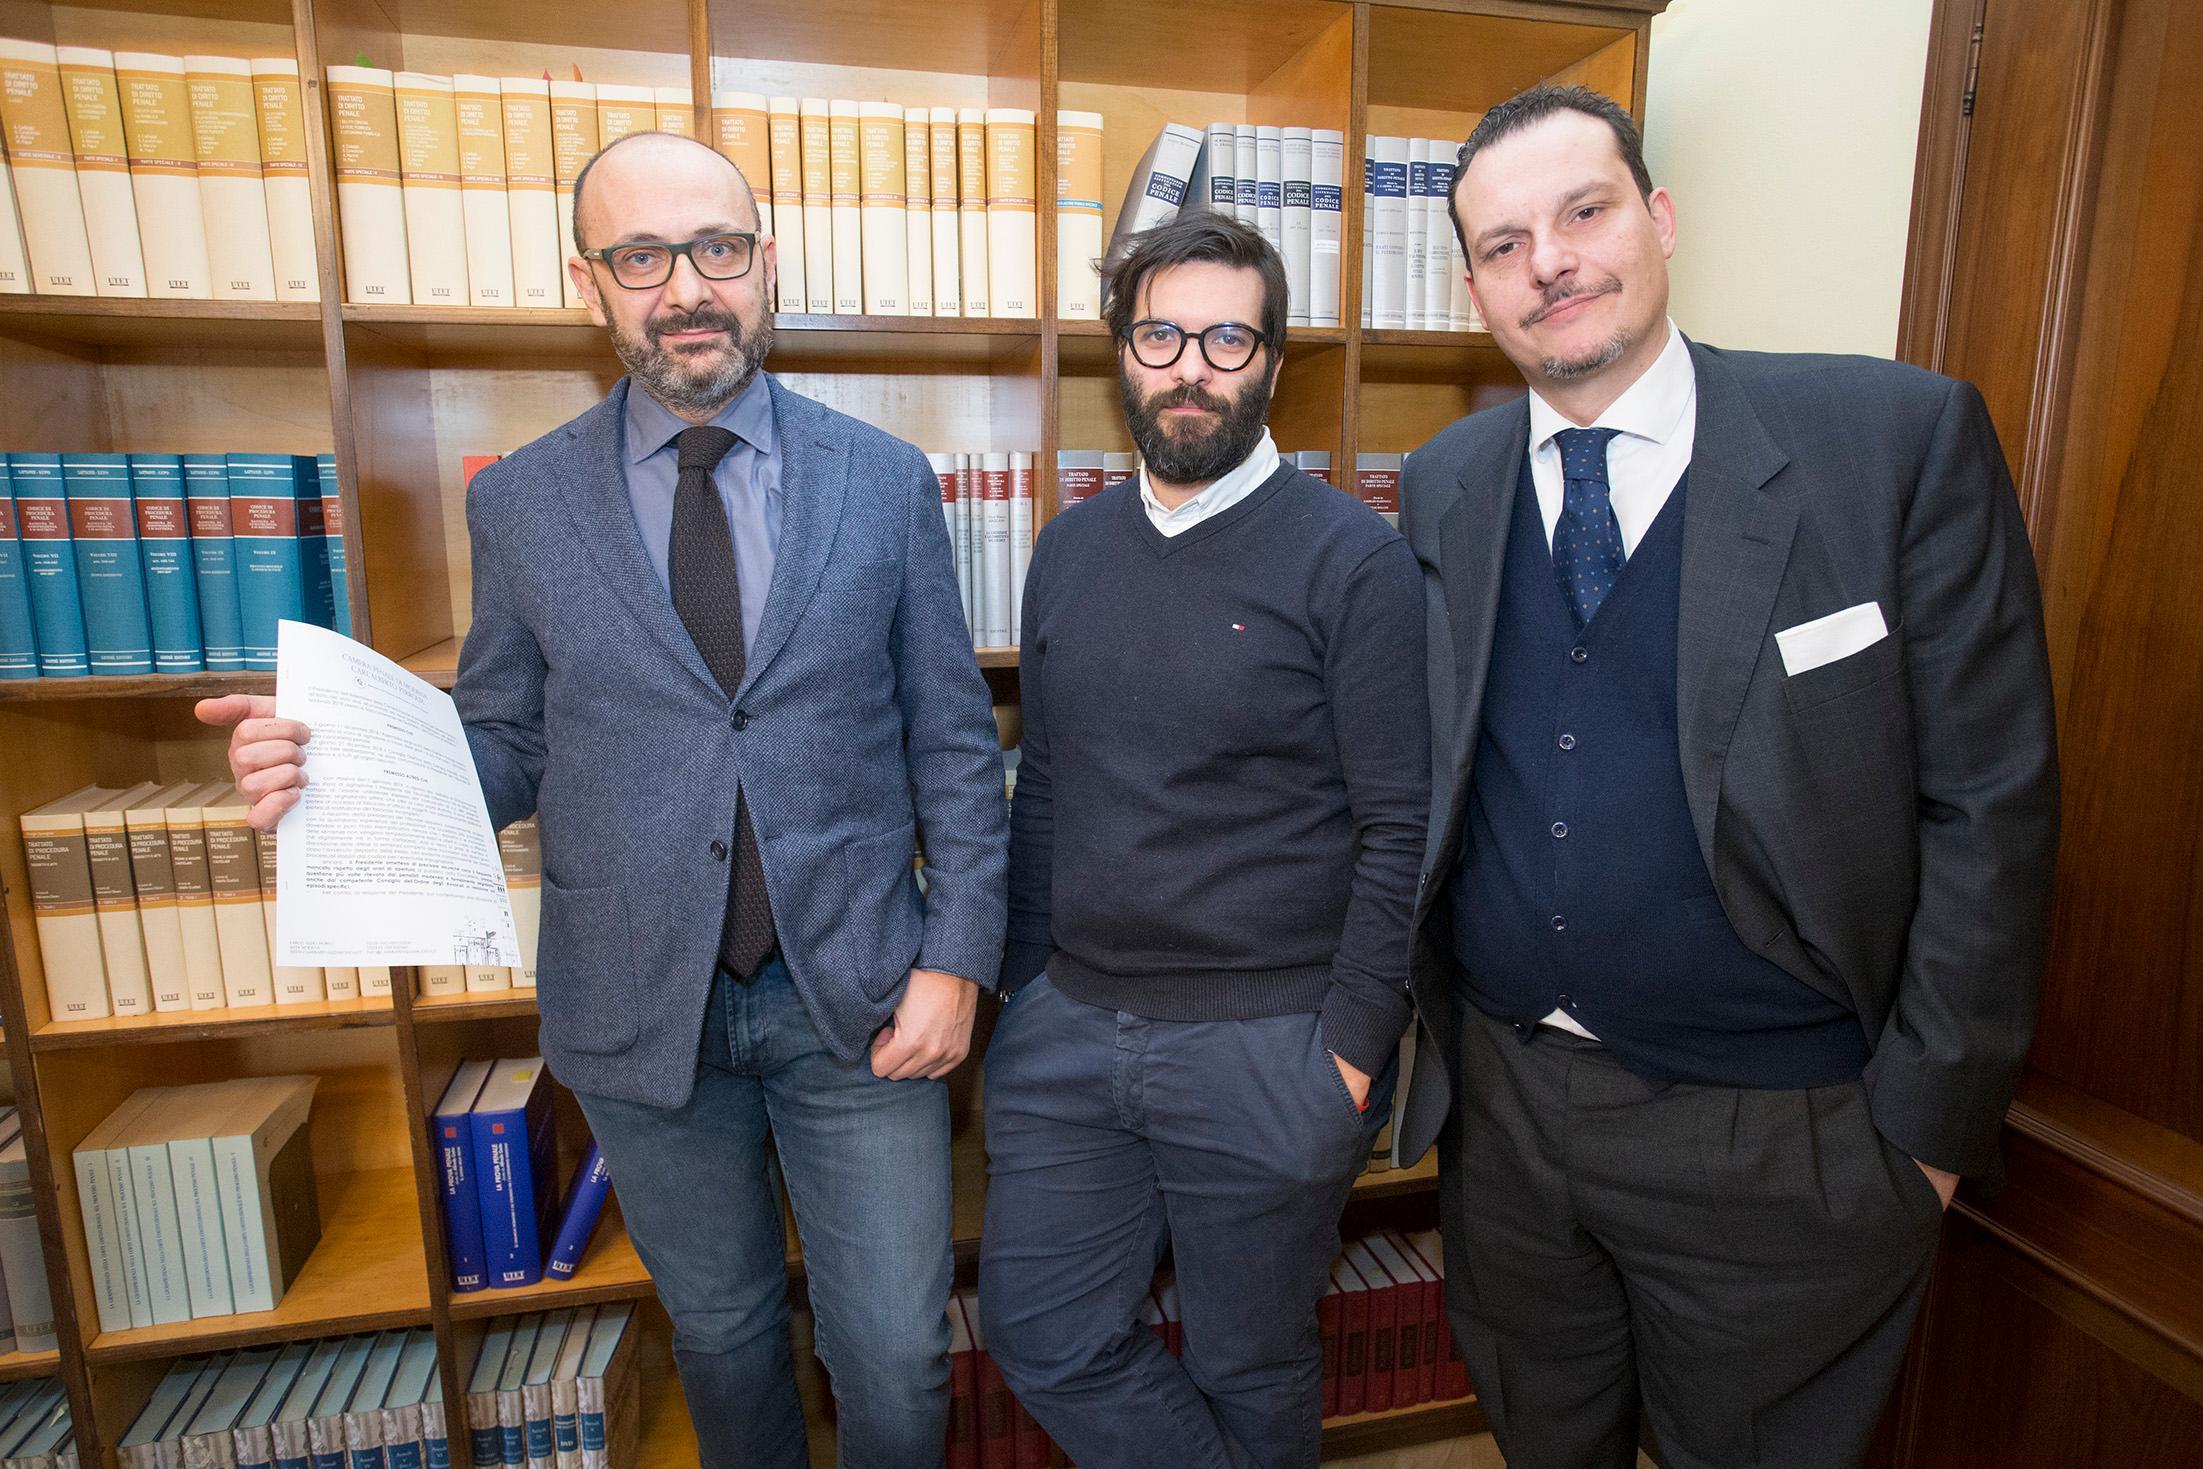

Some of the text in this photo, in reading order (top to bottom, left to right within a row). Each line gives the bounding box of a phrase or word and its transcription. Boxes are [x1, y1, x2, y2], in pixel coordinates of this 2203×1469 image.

[339, 109, 360, 117] PENALE
[1152, 183, 1180, 198] CODICE
[1150, 189, 1179, 203] PENALE
[51, 277, 72, 285] UTET
[108, 277, 129, 286] UTET
[168, 280, 188, 288] UTET
[231, 281, 250, 289] UTET
[239, 988, 256, 996] UTET
[287, 985, 304, 993] UTET
[161, 993, 180, 1001] UTET
[197, 992, 215, 1000] UTET
[67, 1003, 86, 1011] UTET
[444, 1148, 452, 1168] PENALE
[491, 1144, 499, 1165] PENALE
[447, 1169, 455, 1189] PROVA
[494, 1165, 502, 1185] PROVA
[552, 1260, 574, 1272] UTET
[458, 1275, 479, 1285] UTET
[503, 1270, 525, 1281] UTET
